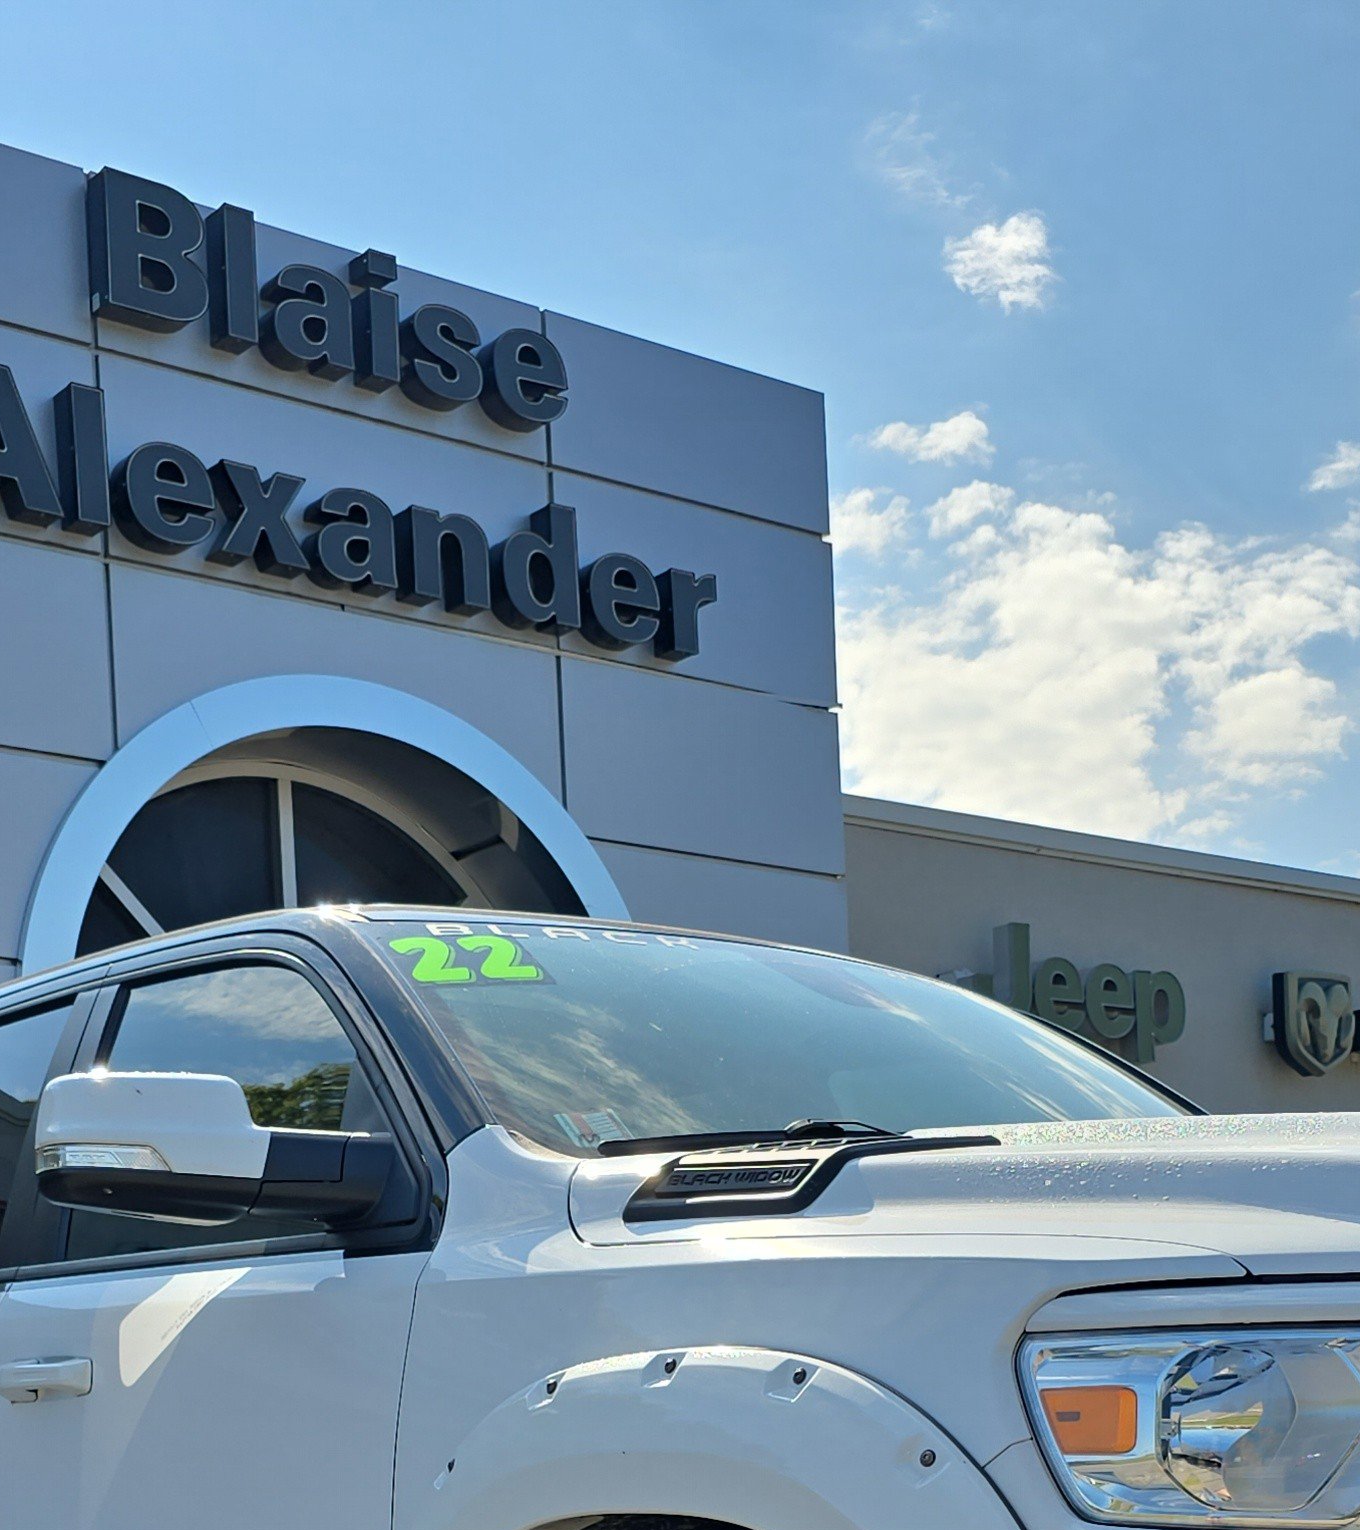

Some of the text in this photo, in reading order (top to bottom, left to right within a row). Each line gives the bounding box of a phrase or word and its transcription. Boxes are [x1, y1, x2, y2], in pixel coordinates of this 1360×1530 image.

[87, 165, 569, 434] Blaise
[388, 935, 545, 984] 22
[425, 923, 700, 950] BLACK
[968, 921, 1186, 1063] Jeep
[667, 1166, 804, 1187] BLACK WIDOW
